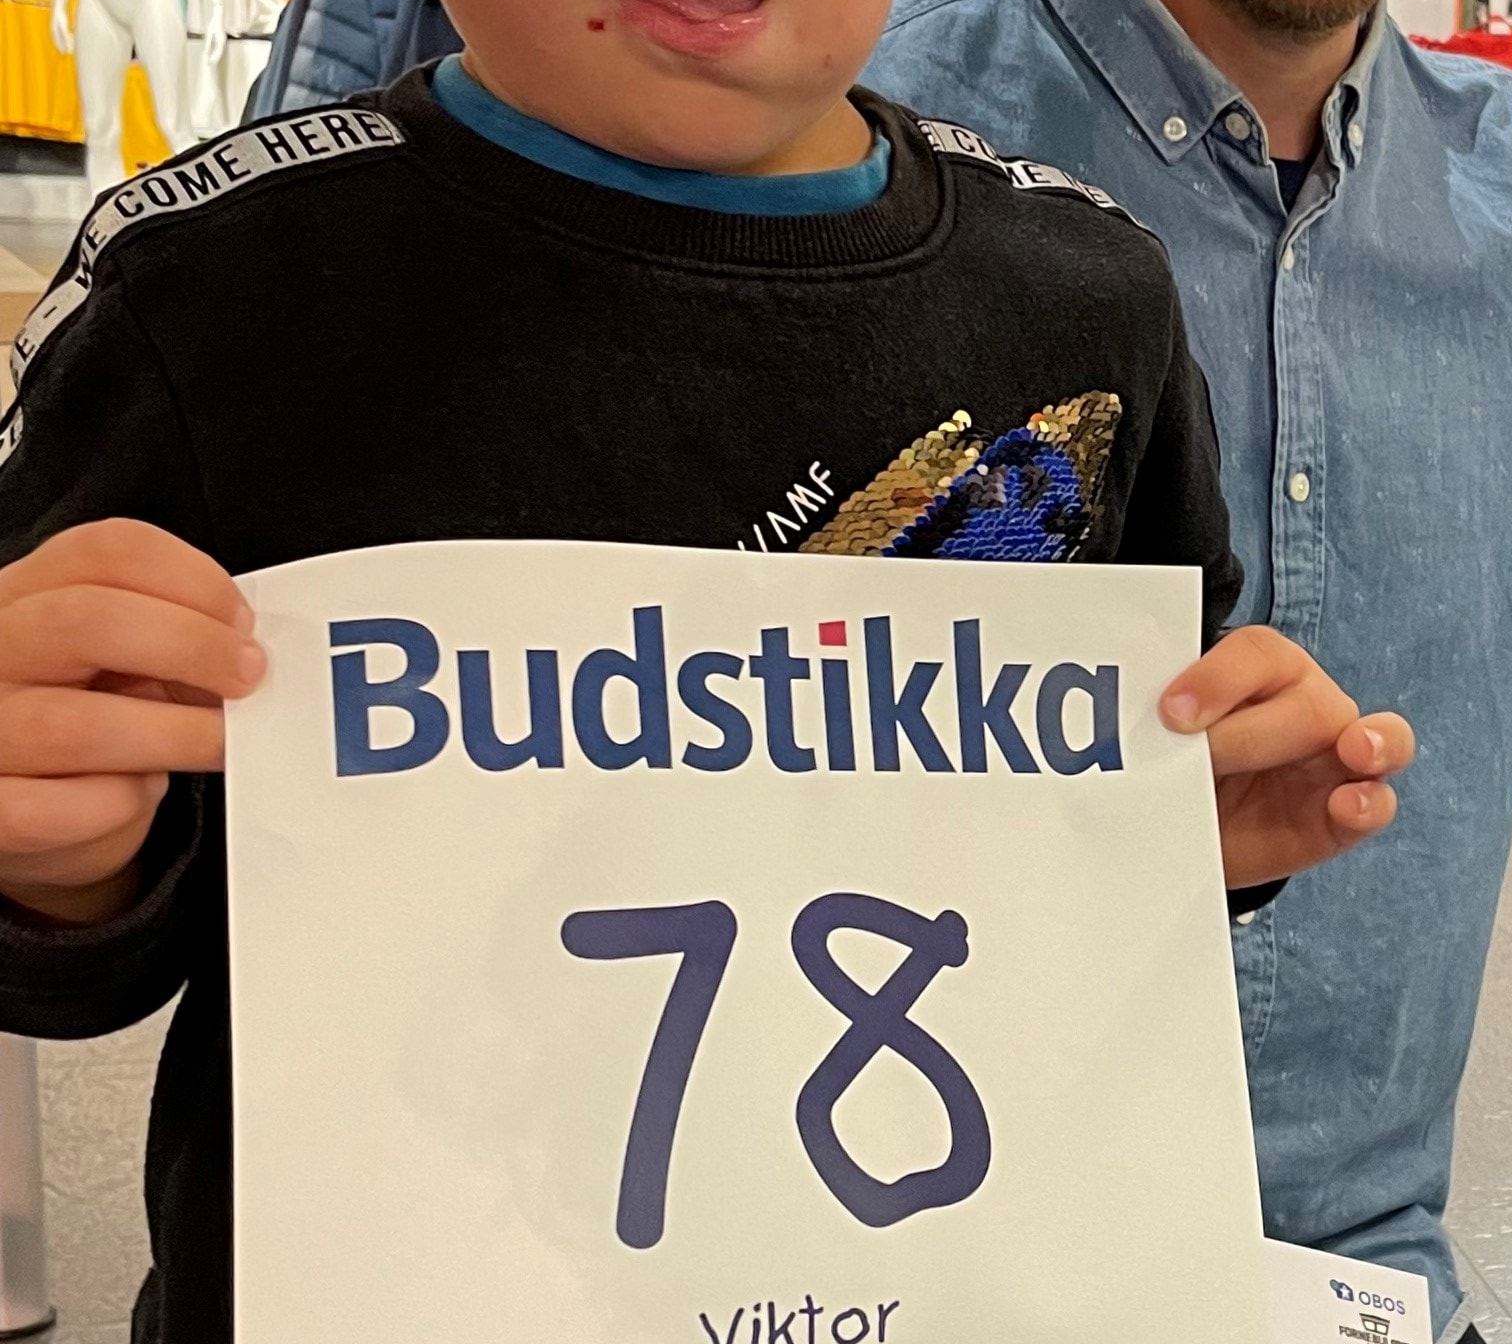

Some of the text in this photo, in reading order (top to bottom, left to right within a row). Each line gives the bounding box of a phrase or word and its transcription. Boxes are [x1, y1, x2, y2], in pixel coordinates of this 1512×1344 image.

[114, 144, 252, 218] COME
[255, 112, 394, 164] HERE
[328, 605, 1124, 778] Budstikka
[560, 892, 992, 1250] 78
[1358, 1291, 1406, 1316] OBOS
